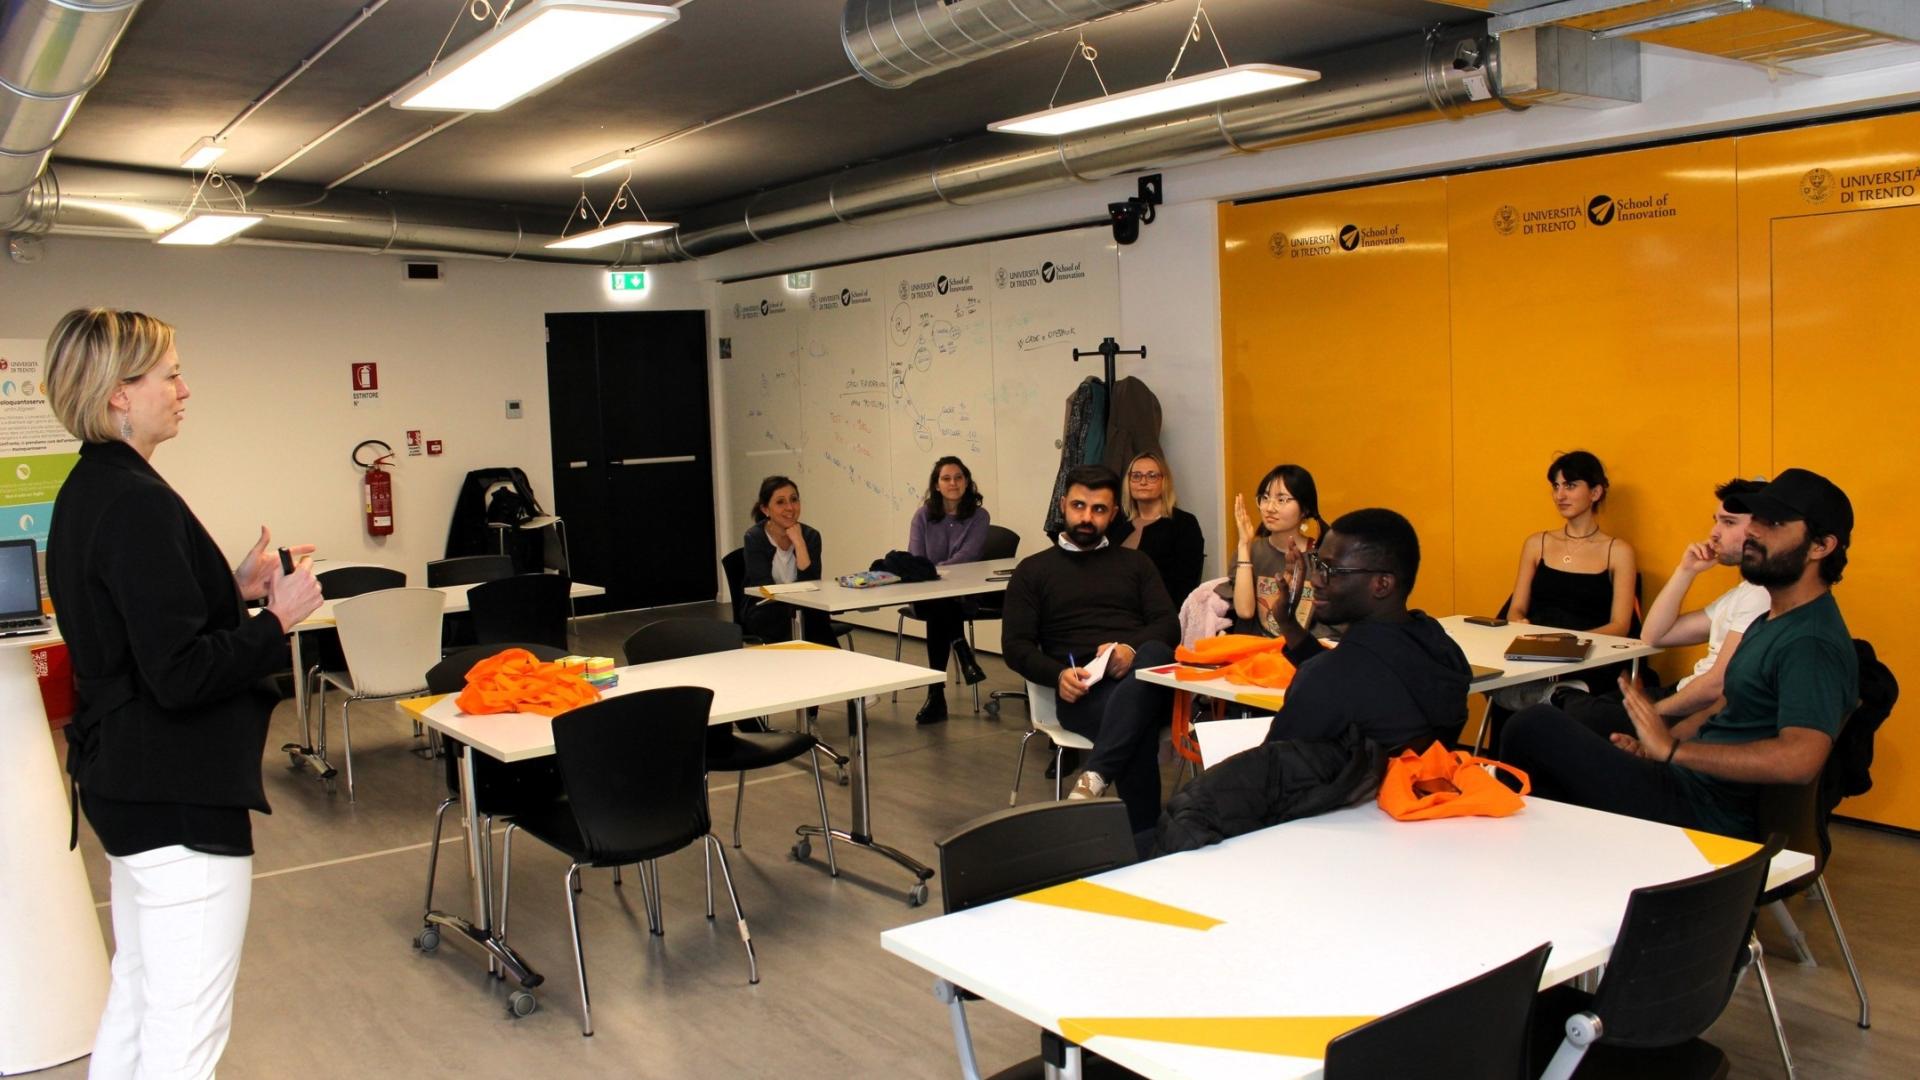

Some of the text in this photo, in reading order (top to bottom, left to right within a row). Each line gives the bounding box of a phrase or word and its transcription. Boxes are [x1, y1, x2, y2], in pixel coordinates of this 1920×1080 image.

[1841, 185, 1914, 203] DI TRENTO
[1617, 193, 1669, 210] School of
[1617, 207, 1676, 222] Innovation
[1360, 224, 1400, 238] School of
[1523, 220, 1576, 235] DI TRENTO
[1361, 235, 1405, 248] Innovation
[1291, 246, 1331, 258] DI TRENTO
[1056, 262, 1081, 272] School of
[1016, 278, 1037, 287] TRENTO
